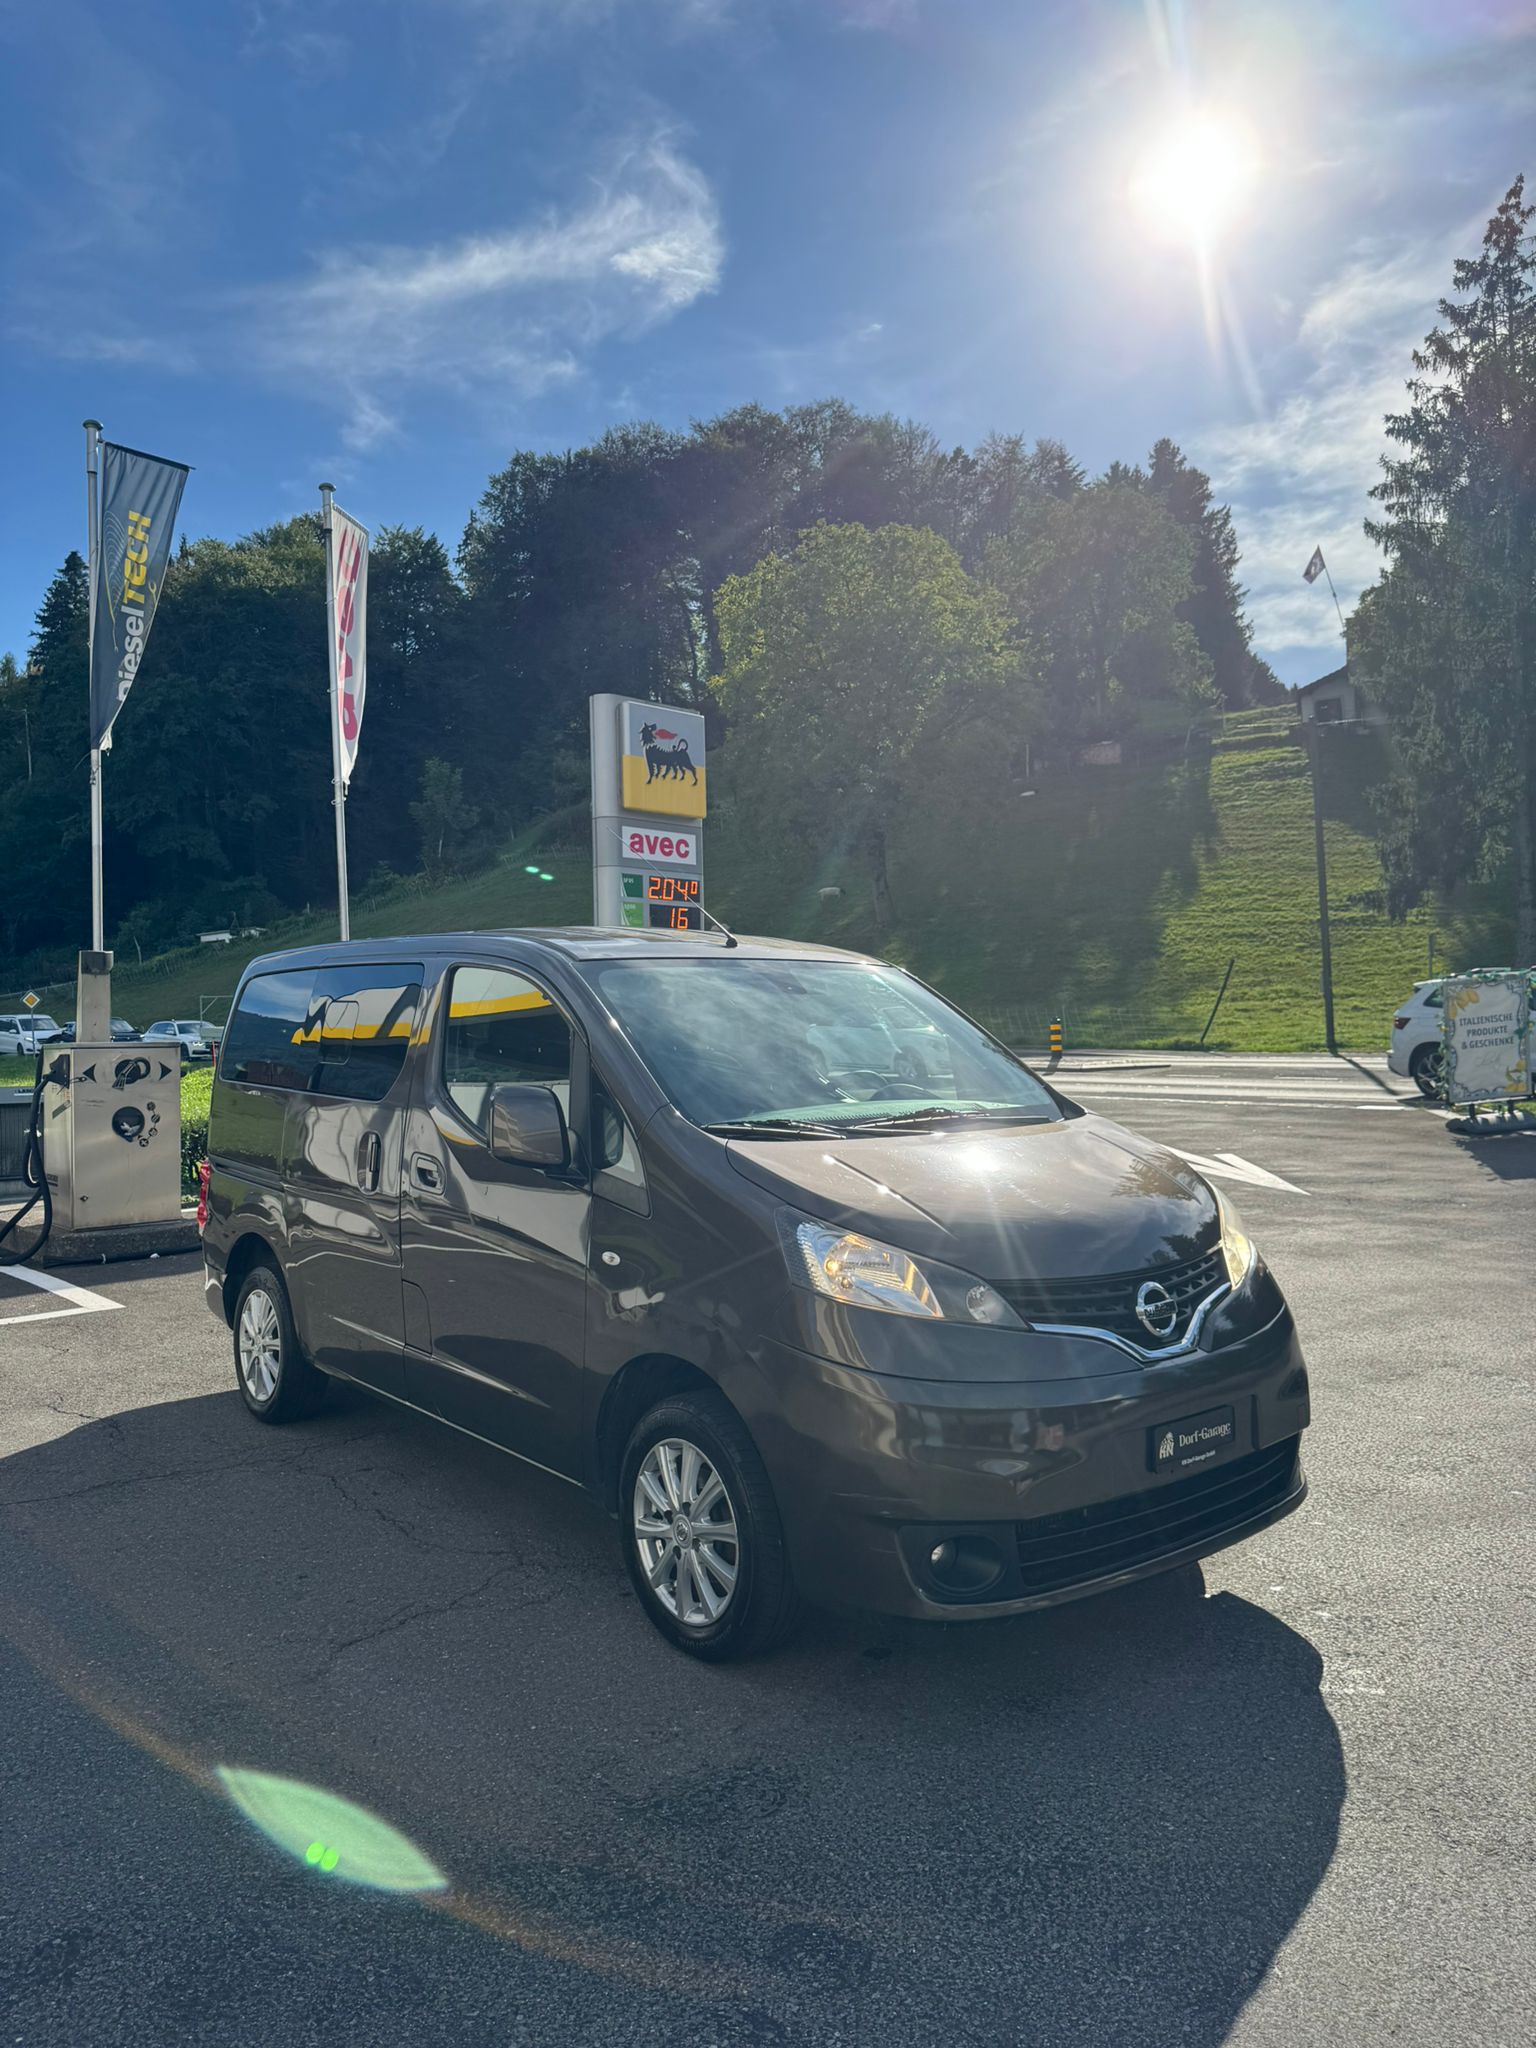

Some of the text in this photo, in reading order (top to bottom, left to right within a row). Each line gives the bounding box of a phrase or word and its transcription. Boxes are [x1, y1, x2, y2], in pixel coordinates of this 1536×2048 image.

[629, 832, 690, 859] avec
[1460, 1012, 1513, 1026] ITALIENISCHE
[1466, 1025, 1508, 1037] PRODUKTE
[1469, 1036, 1514, 1049] GESCHENKE
[1179, 1422, 1231, 1447] Dorf-Garage
